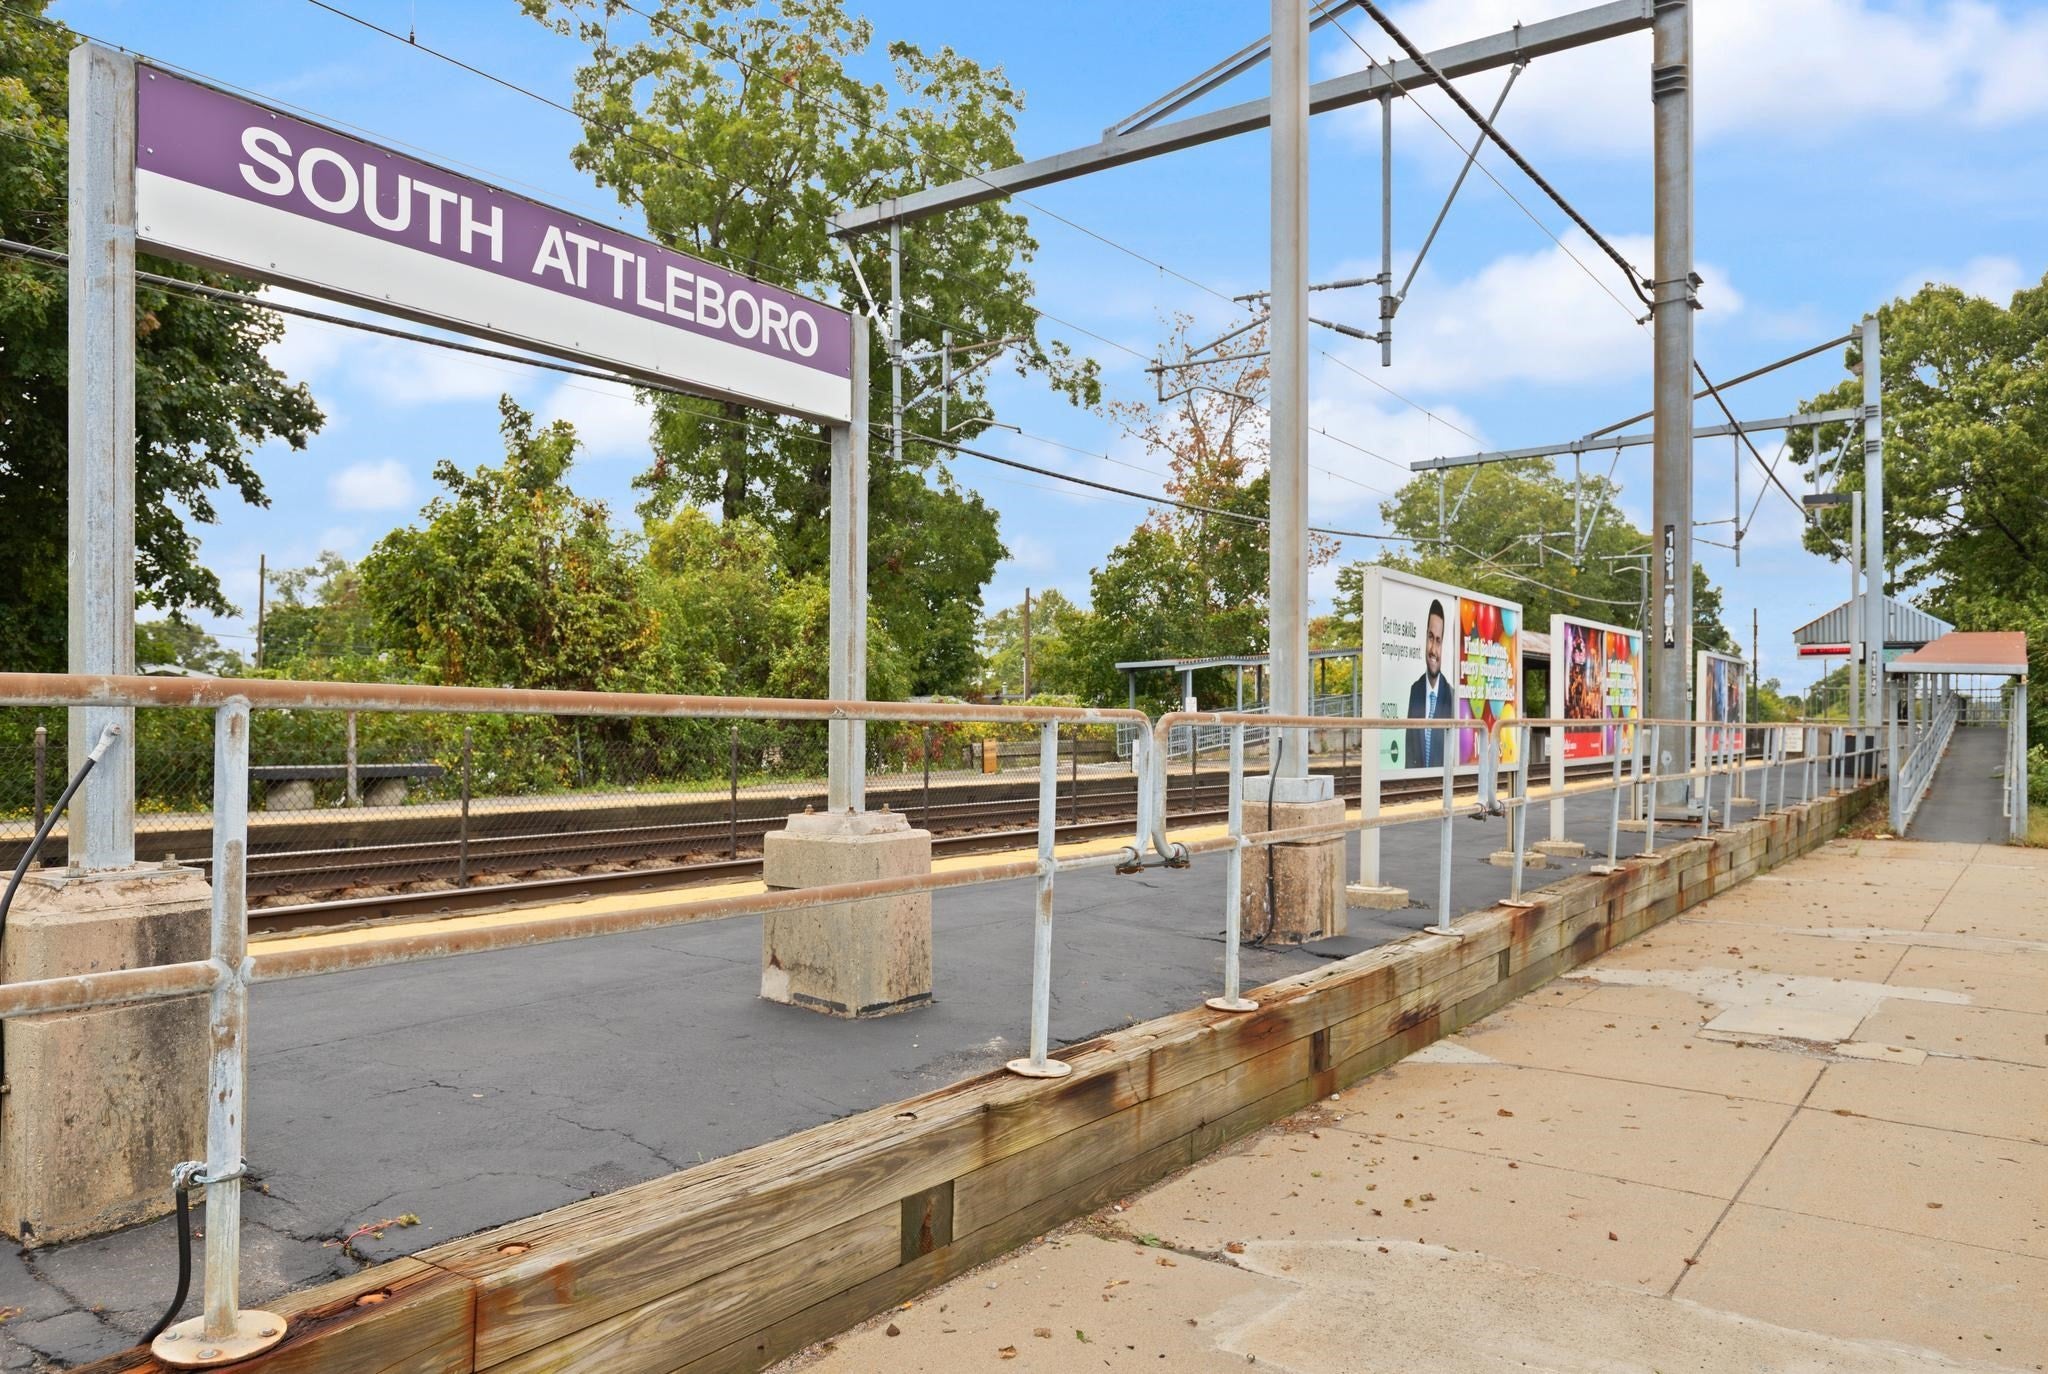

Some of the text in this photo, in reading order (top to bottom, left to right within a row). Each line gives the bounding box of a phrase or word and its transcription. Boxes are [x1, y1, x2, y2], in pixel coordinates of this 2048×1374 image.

[239, 126, 819, 358] SOUTH ATTLEBORO
[1383, 616, 1392, 633] Get
[1402, 621, 1416, 639] skills
[1382, 641, 1408, 661] employers
